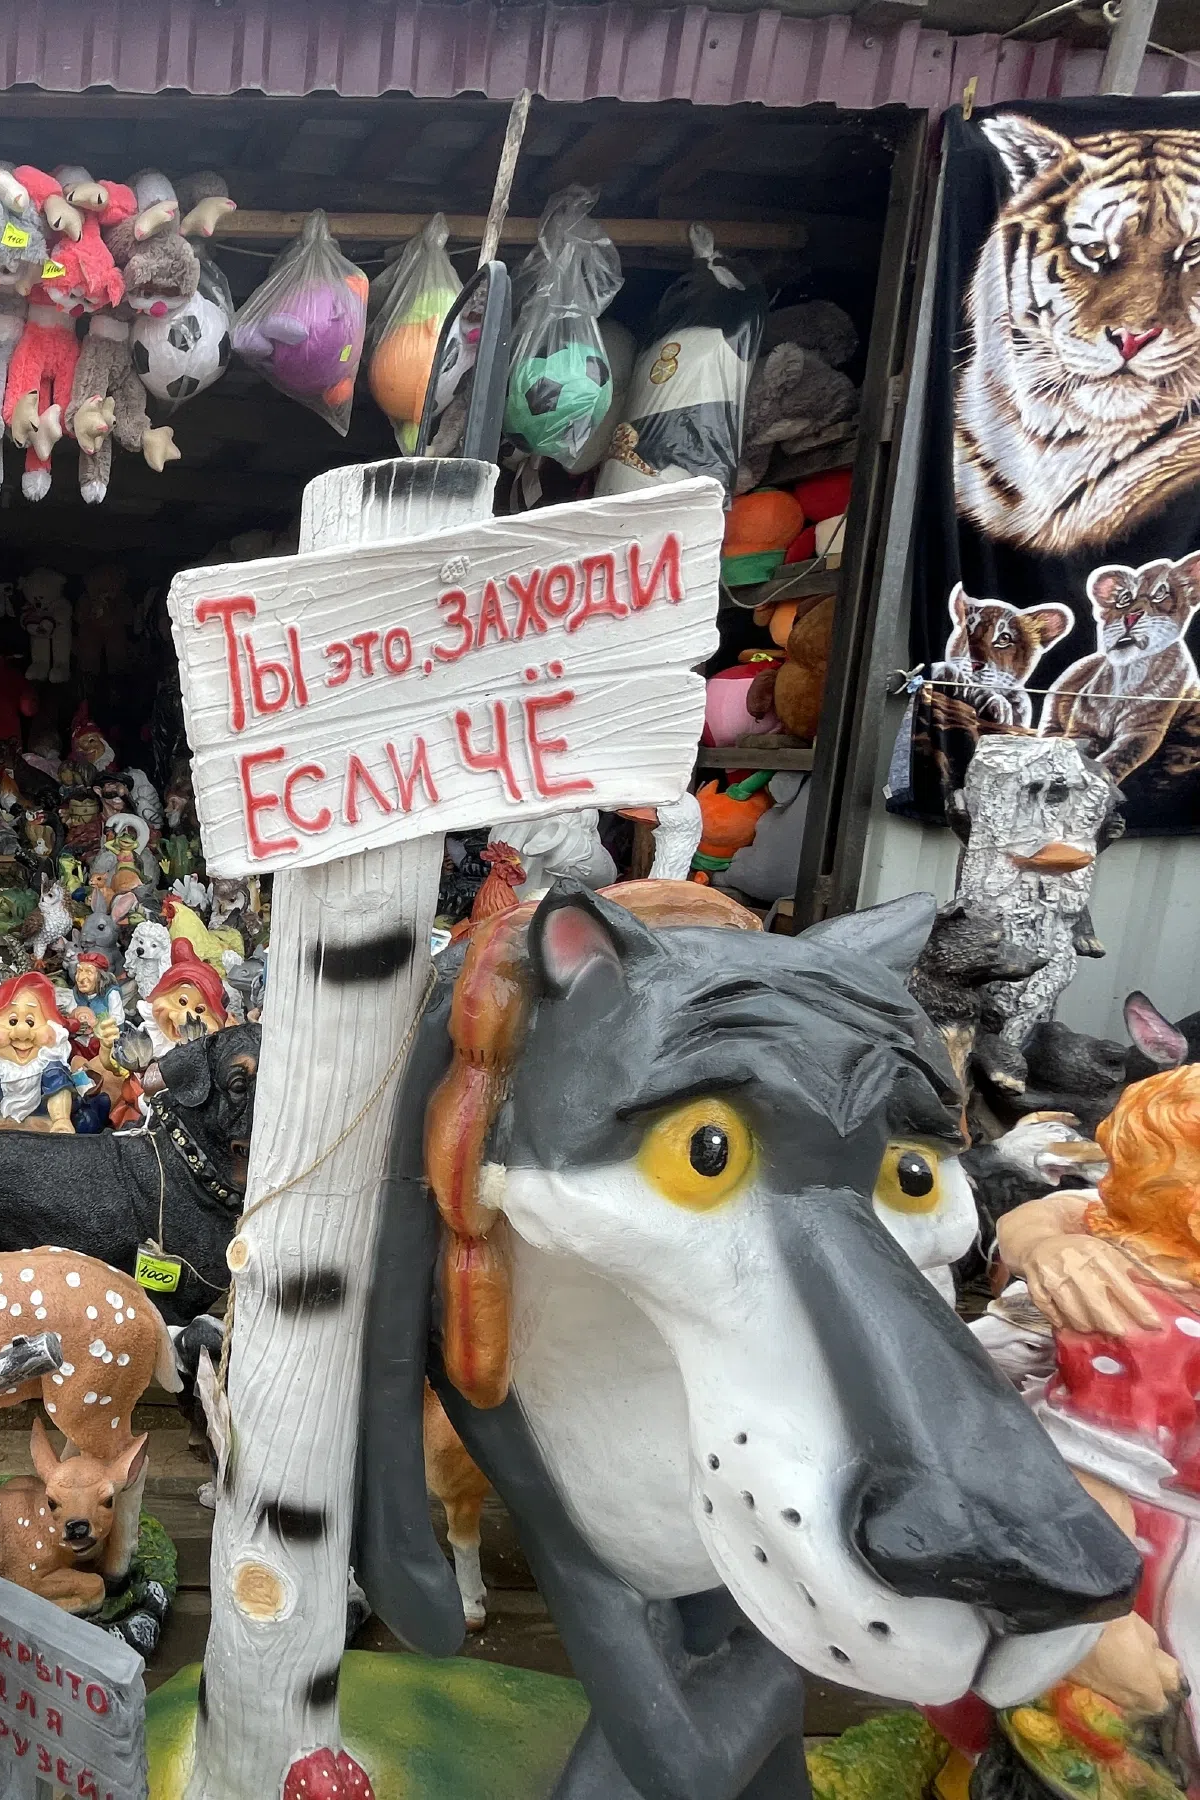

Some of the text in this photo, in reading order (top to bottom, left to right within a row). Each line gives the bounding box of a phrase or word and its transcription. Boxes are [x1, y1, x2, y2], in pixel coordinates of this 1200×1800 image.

[434, 530, 684, 661] ЗАХОДИ
[453, 658, 596, 802] ЧЁ
[140, 1265, 174, 1283] 4000
